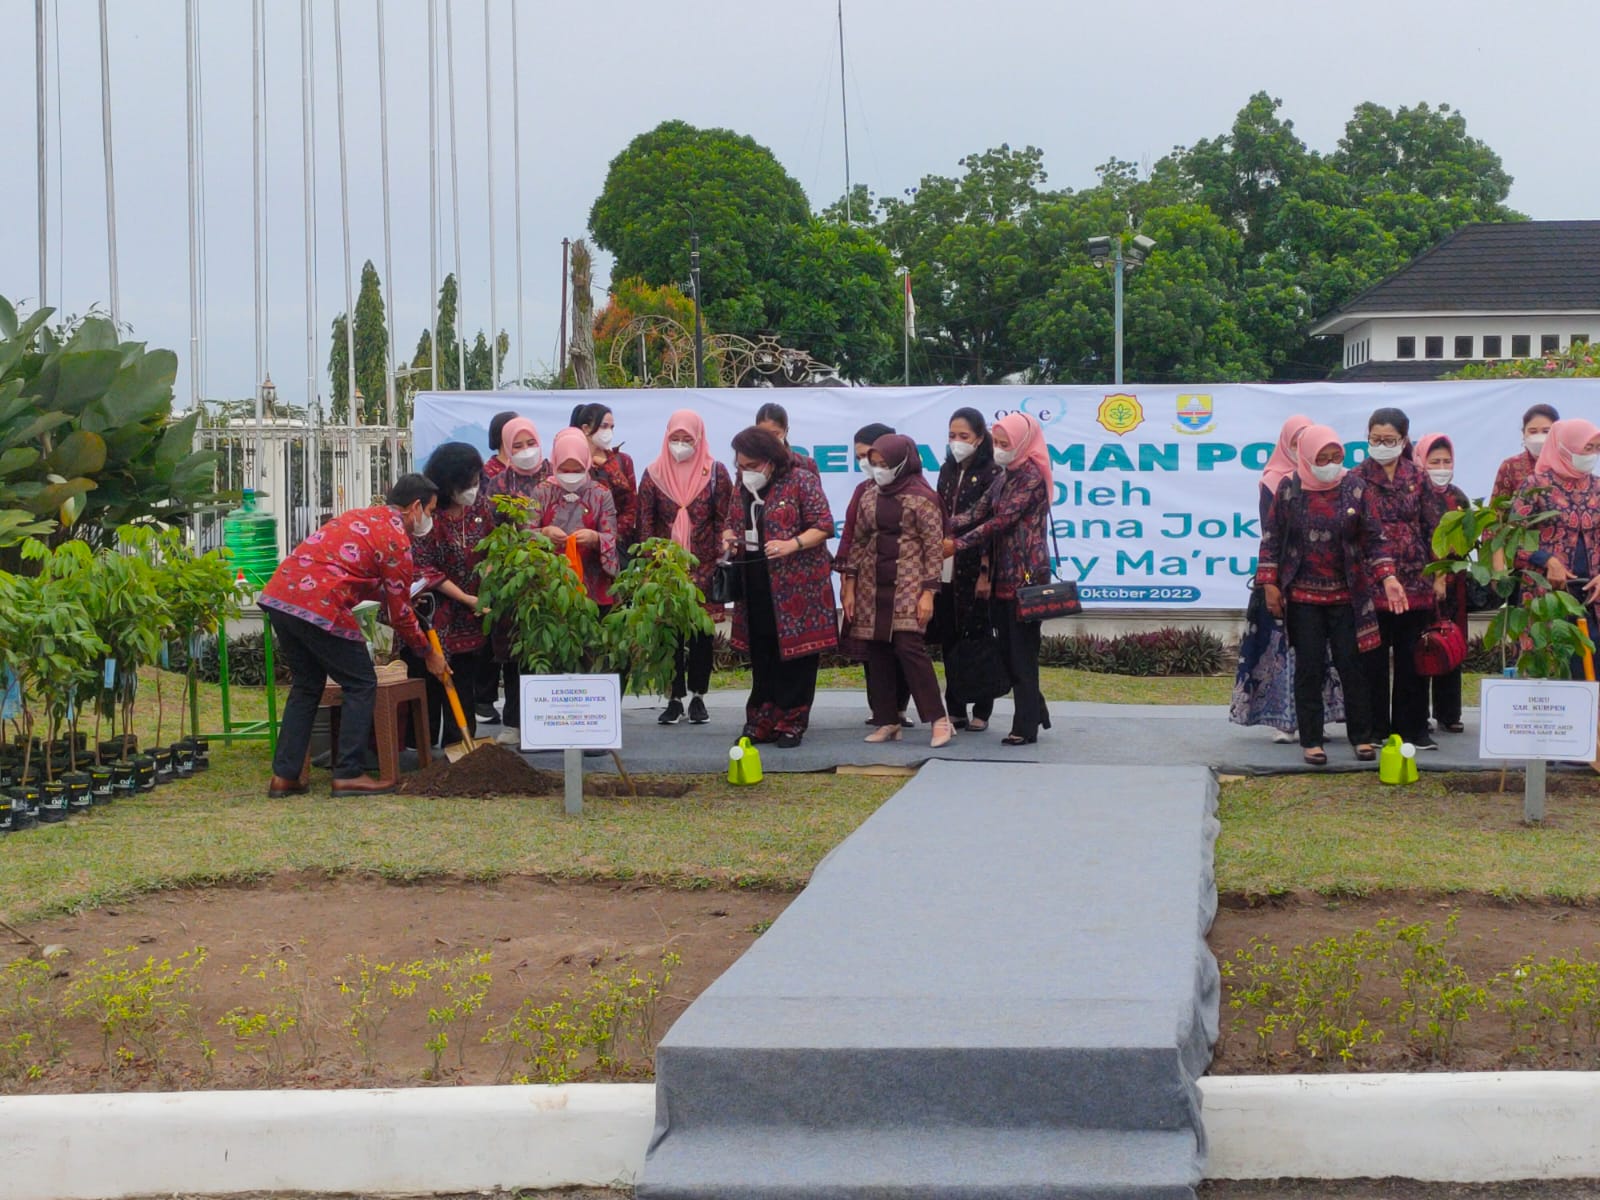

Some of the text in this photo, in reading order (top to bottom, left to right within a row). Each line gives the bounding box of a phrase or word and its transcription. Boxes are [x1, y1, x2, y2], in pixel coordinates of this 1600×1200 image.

[1160, 512, 1260, 539] Jok
[1116, 550, 1258, 576] Ma'ru
[1080, 588, 1193, 599] Oktober 2022
